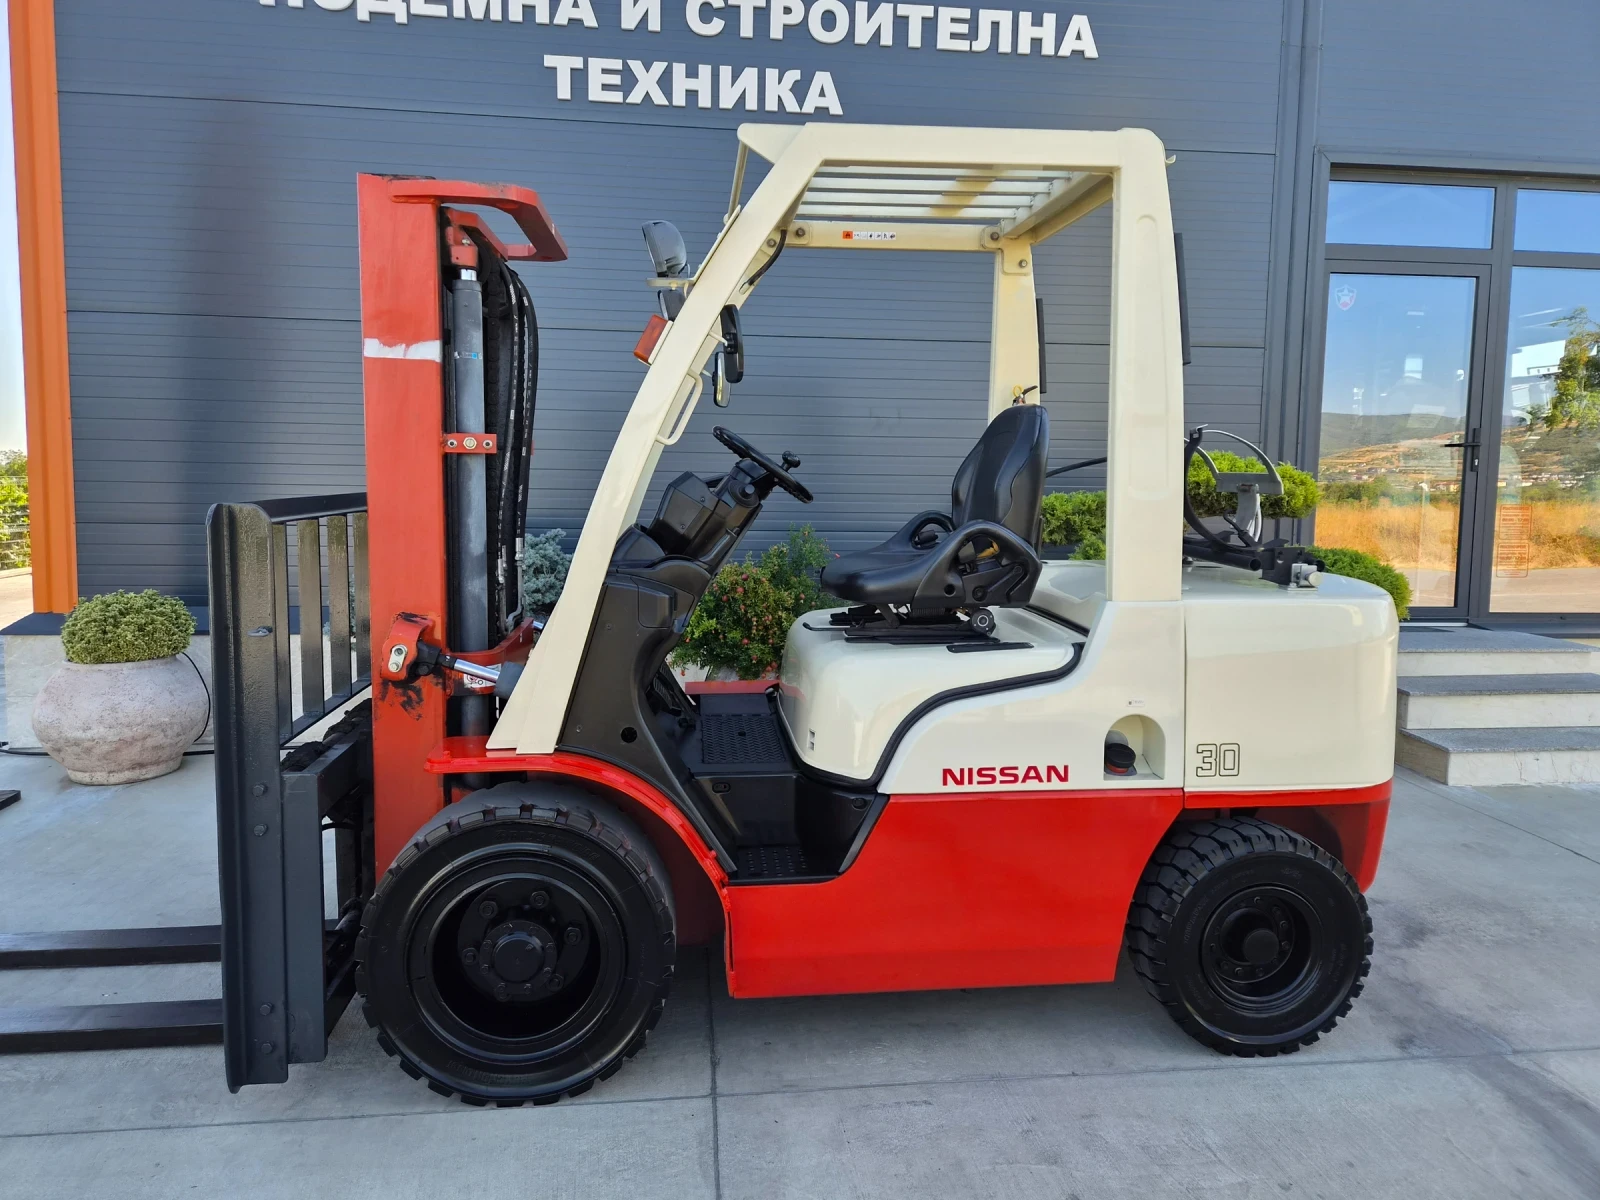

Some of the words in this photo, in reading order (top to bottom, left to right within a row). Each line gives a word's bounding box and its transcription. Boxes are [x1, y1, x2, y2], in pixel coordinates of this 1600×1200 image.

[620, 0, 661, 33] И
[684, 0, 1099, 60] СТРОИТЕЛНА
[543, 54, 845, 117] ТЕХНИКА
[942, 764, 1069, 787] NISSAN
[1196, 743, 1240, 777] 30
